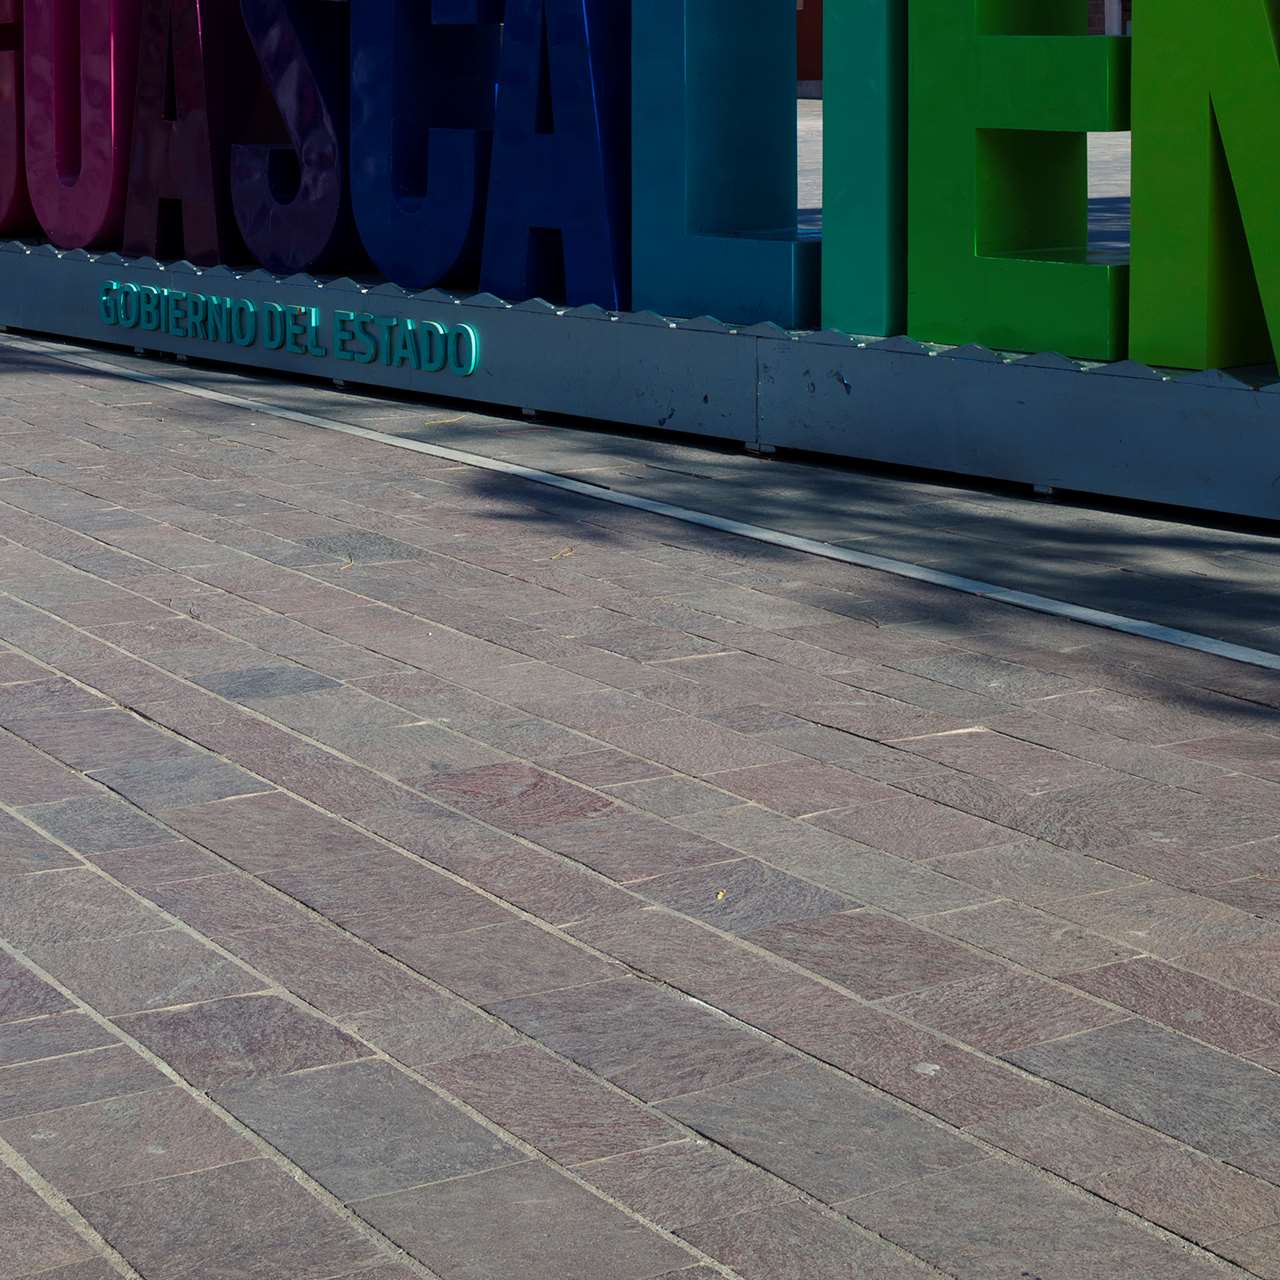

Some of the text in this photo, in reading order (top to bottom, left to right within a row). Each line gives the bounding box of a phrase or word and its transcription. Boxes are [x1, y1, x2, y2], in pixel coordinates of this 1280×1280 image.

[98, 280, 481, 377] GOBIERNO DEL ESTADO
